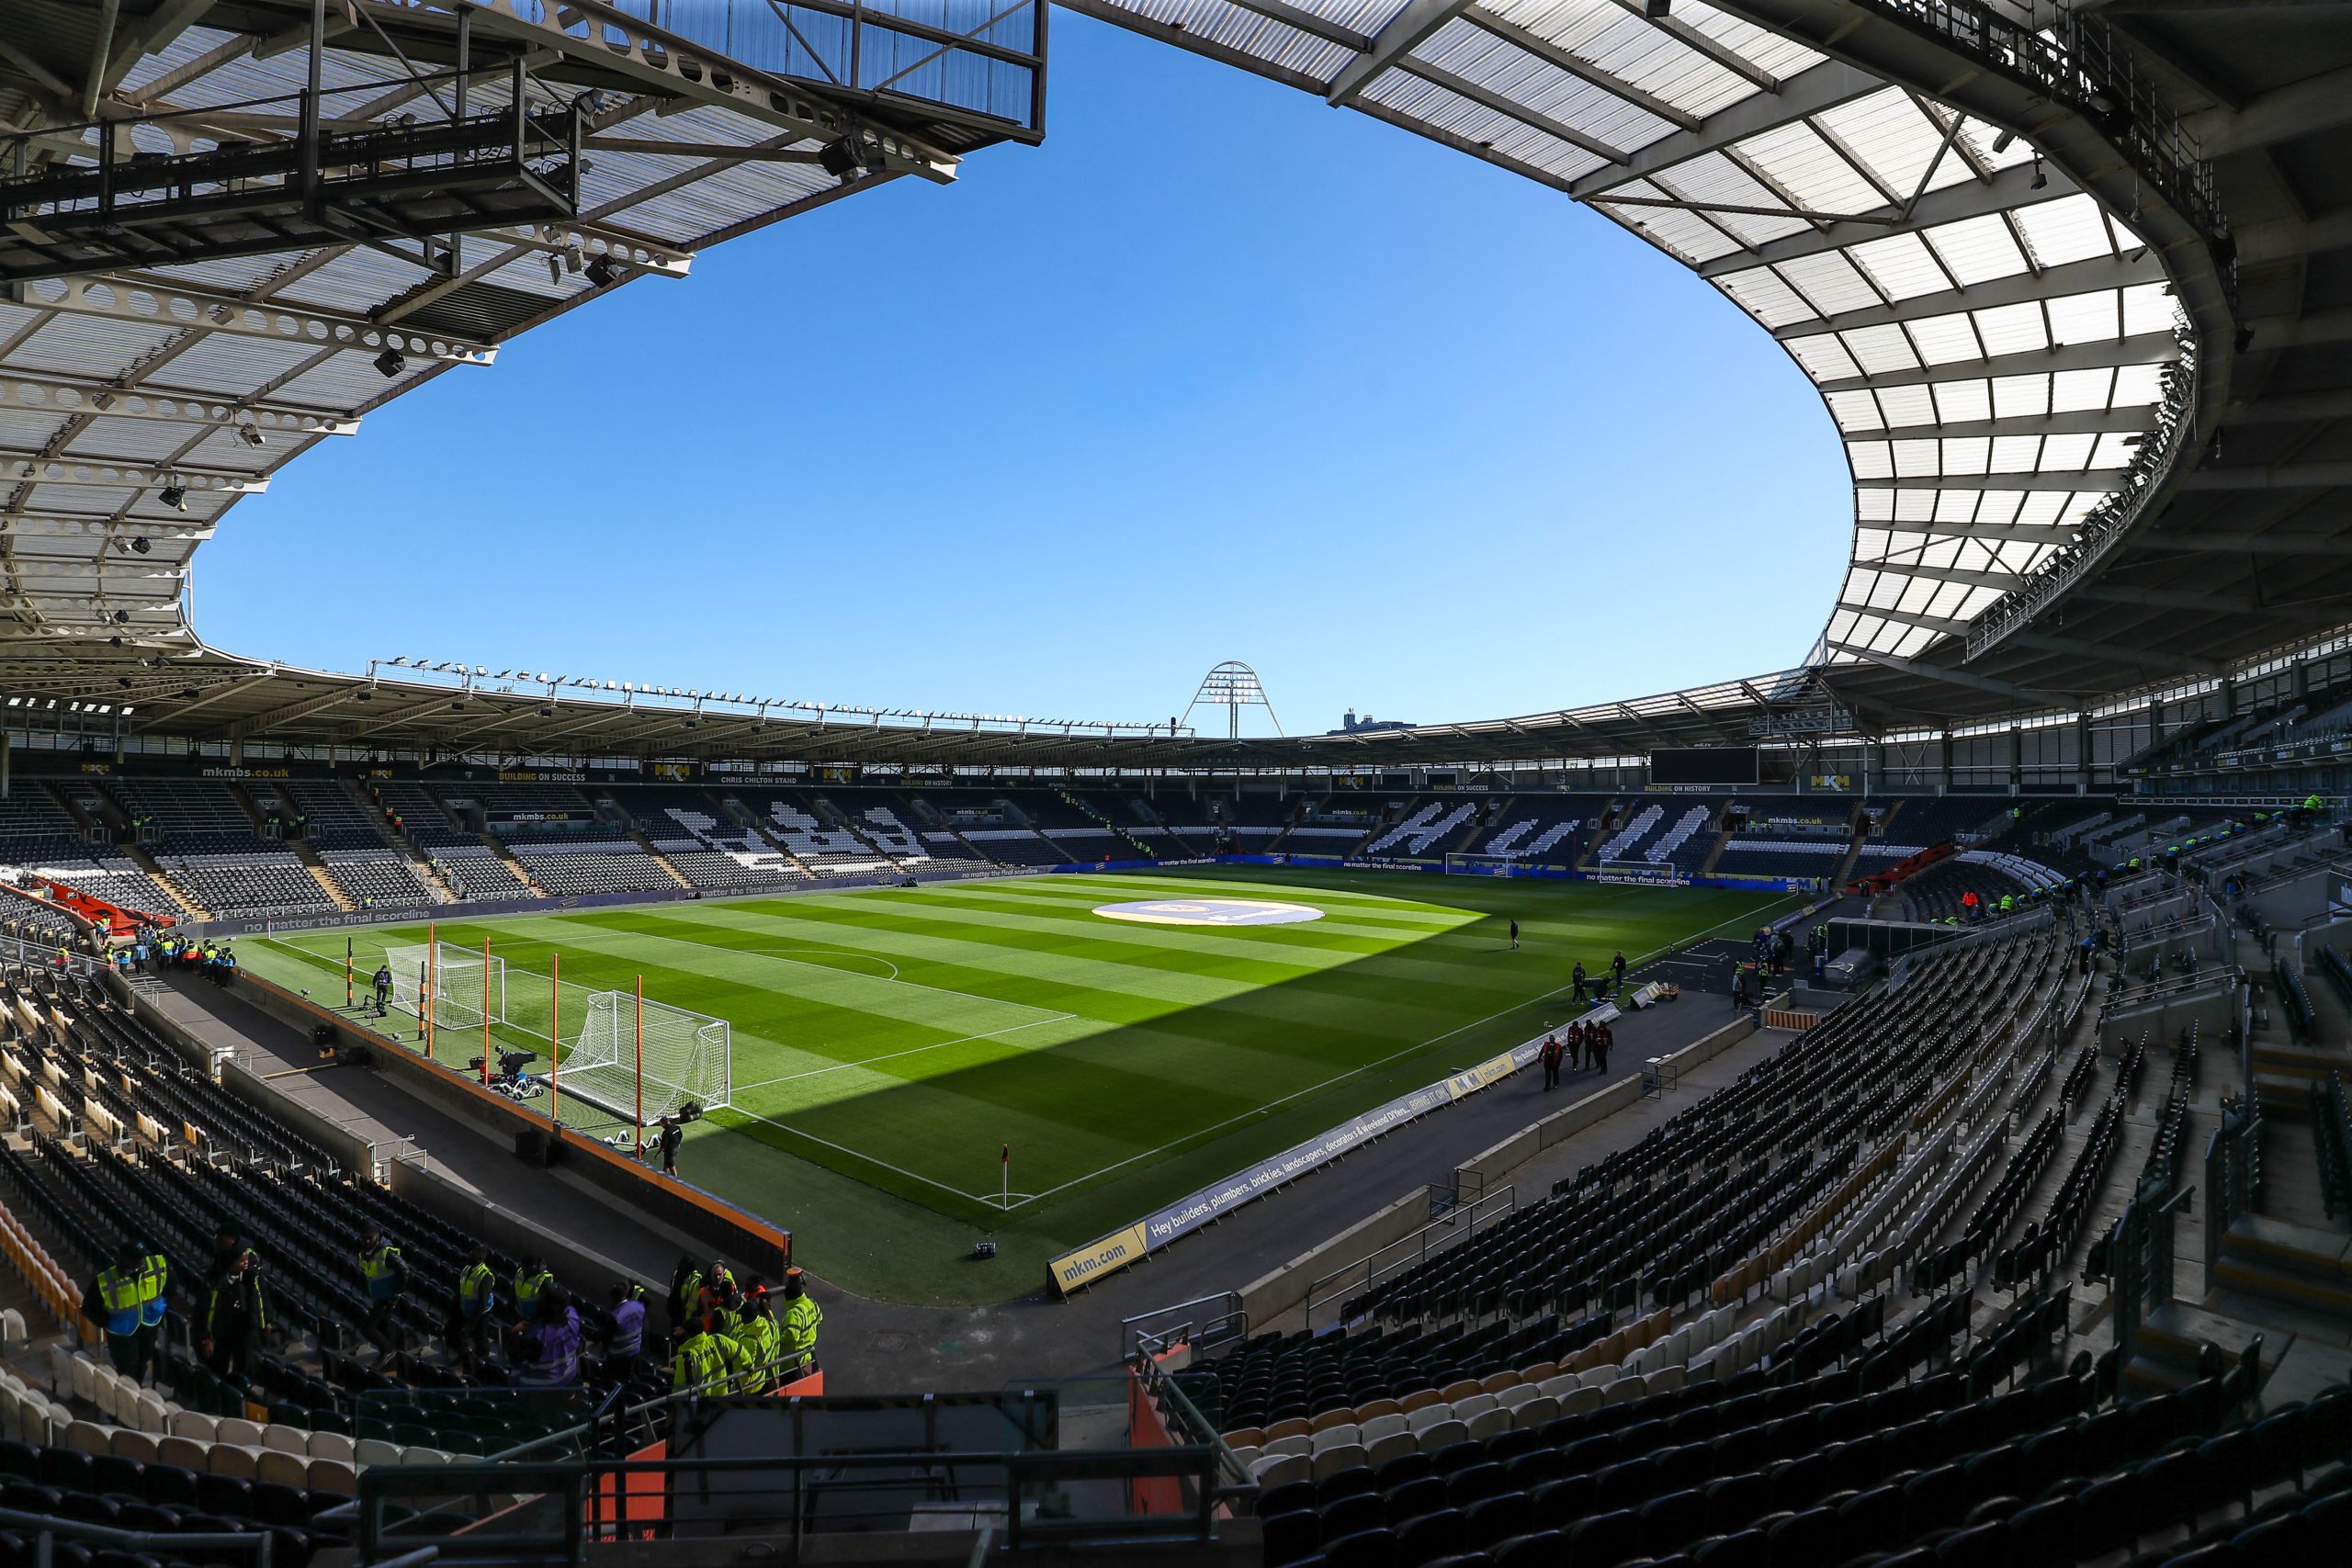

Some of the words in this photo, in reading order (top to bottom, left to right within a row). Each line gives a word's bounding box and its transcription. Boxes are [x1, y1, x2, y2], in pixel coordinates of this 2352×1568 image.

[202, 766, 289, 777] mkmbs.co.uk
[499, 773, 537, 781] BUILDING
[551, 773, 585, 782] SUCCESS
[655, 764, 690, 781] MKM
[823, 768, 853, 784] MKM
[1812, 775, 1849, 791] MKM
[513, 812, 569, 820] mkmbs.co.uk
[1768, 817, 1823, 825] mkmbs.co.uk
[1637, 875, 1655, 884] final
[701, 888, 729, 897] matter
[746, 886, 763, 894] final
[245, 922, 263, 932] no
[266, 918, 316, 931] matter
[318, 915, 341, 926] the
[344, 912, 372, 924] final
[375, 909, 430, 921] scoreline
[1409, 1095, 1430, 1110] BRING
[1428, 1091, 1437, 1102] IT
[1435, 1088, 1449, 1100] ON
[1150, 1222, 1172, 1237] Hey
[1173, 1201, 1212, 1227] builders,
[1210, 1183, 1252, 1210] plumbers,
[1250, 1168, 1285, 1190] brickies,
[1283, 1145, 1328, 1171] landscapers,
[1325, 1130, 1359, 1153] decorators
[1356, 1126, 1364, 1135] &
[1361, 1114, 1389, 1133] weekend
[1062, 1243, 1126, 1281] mkm.com
